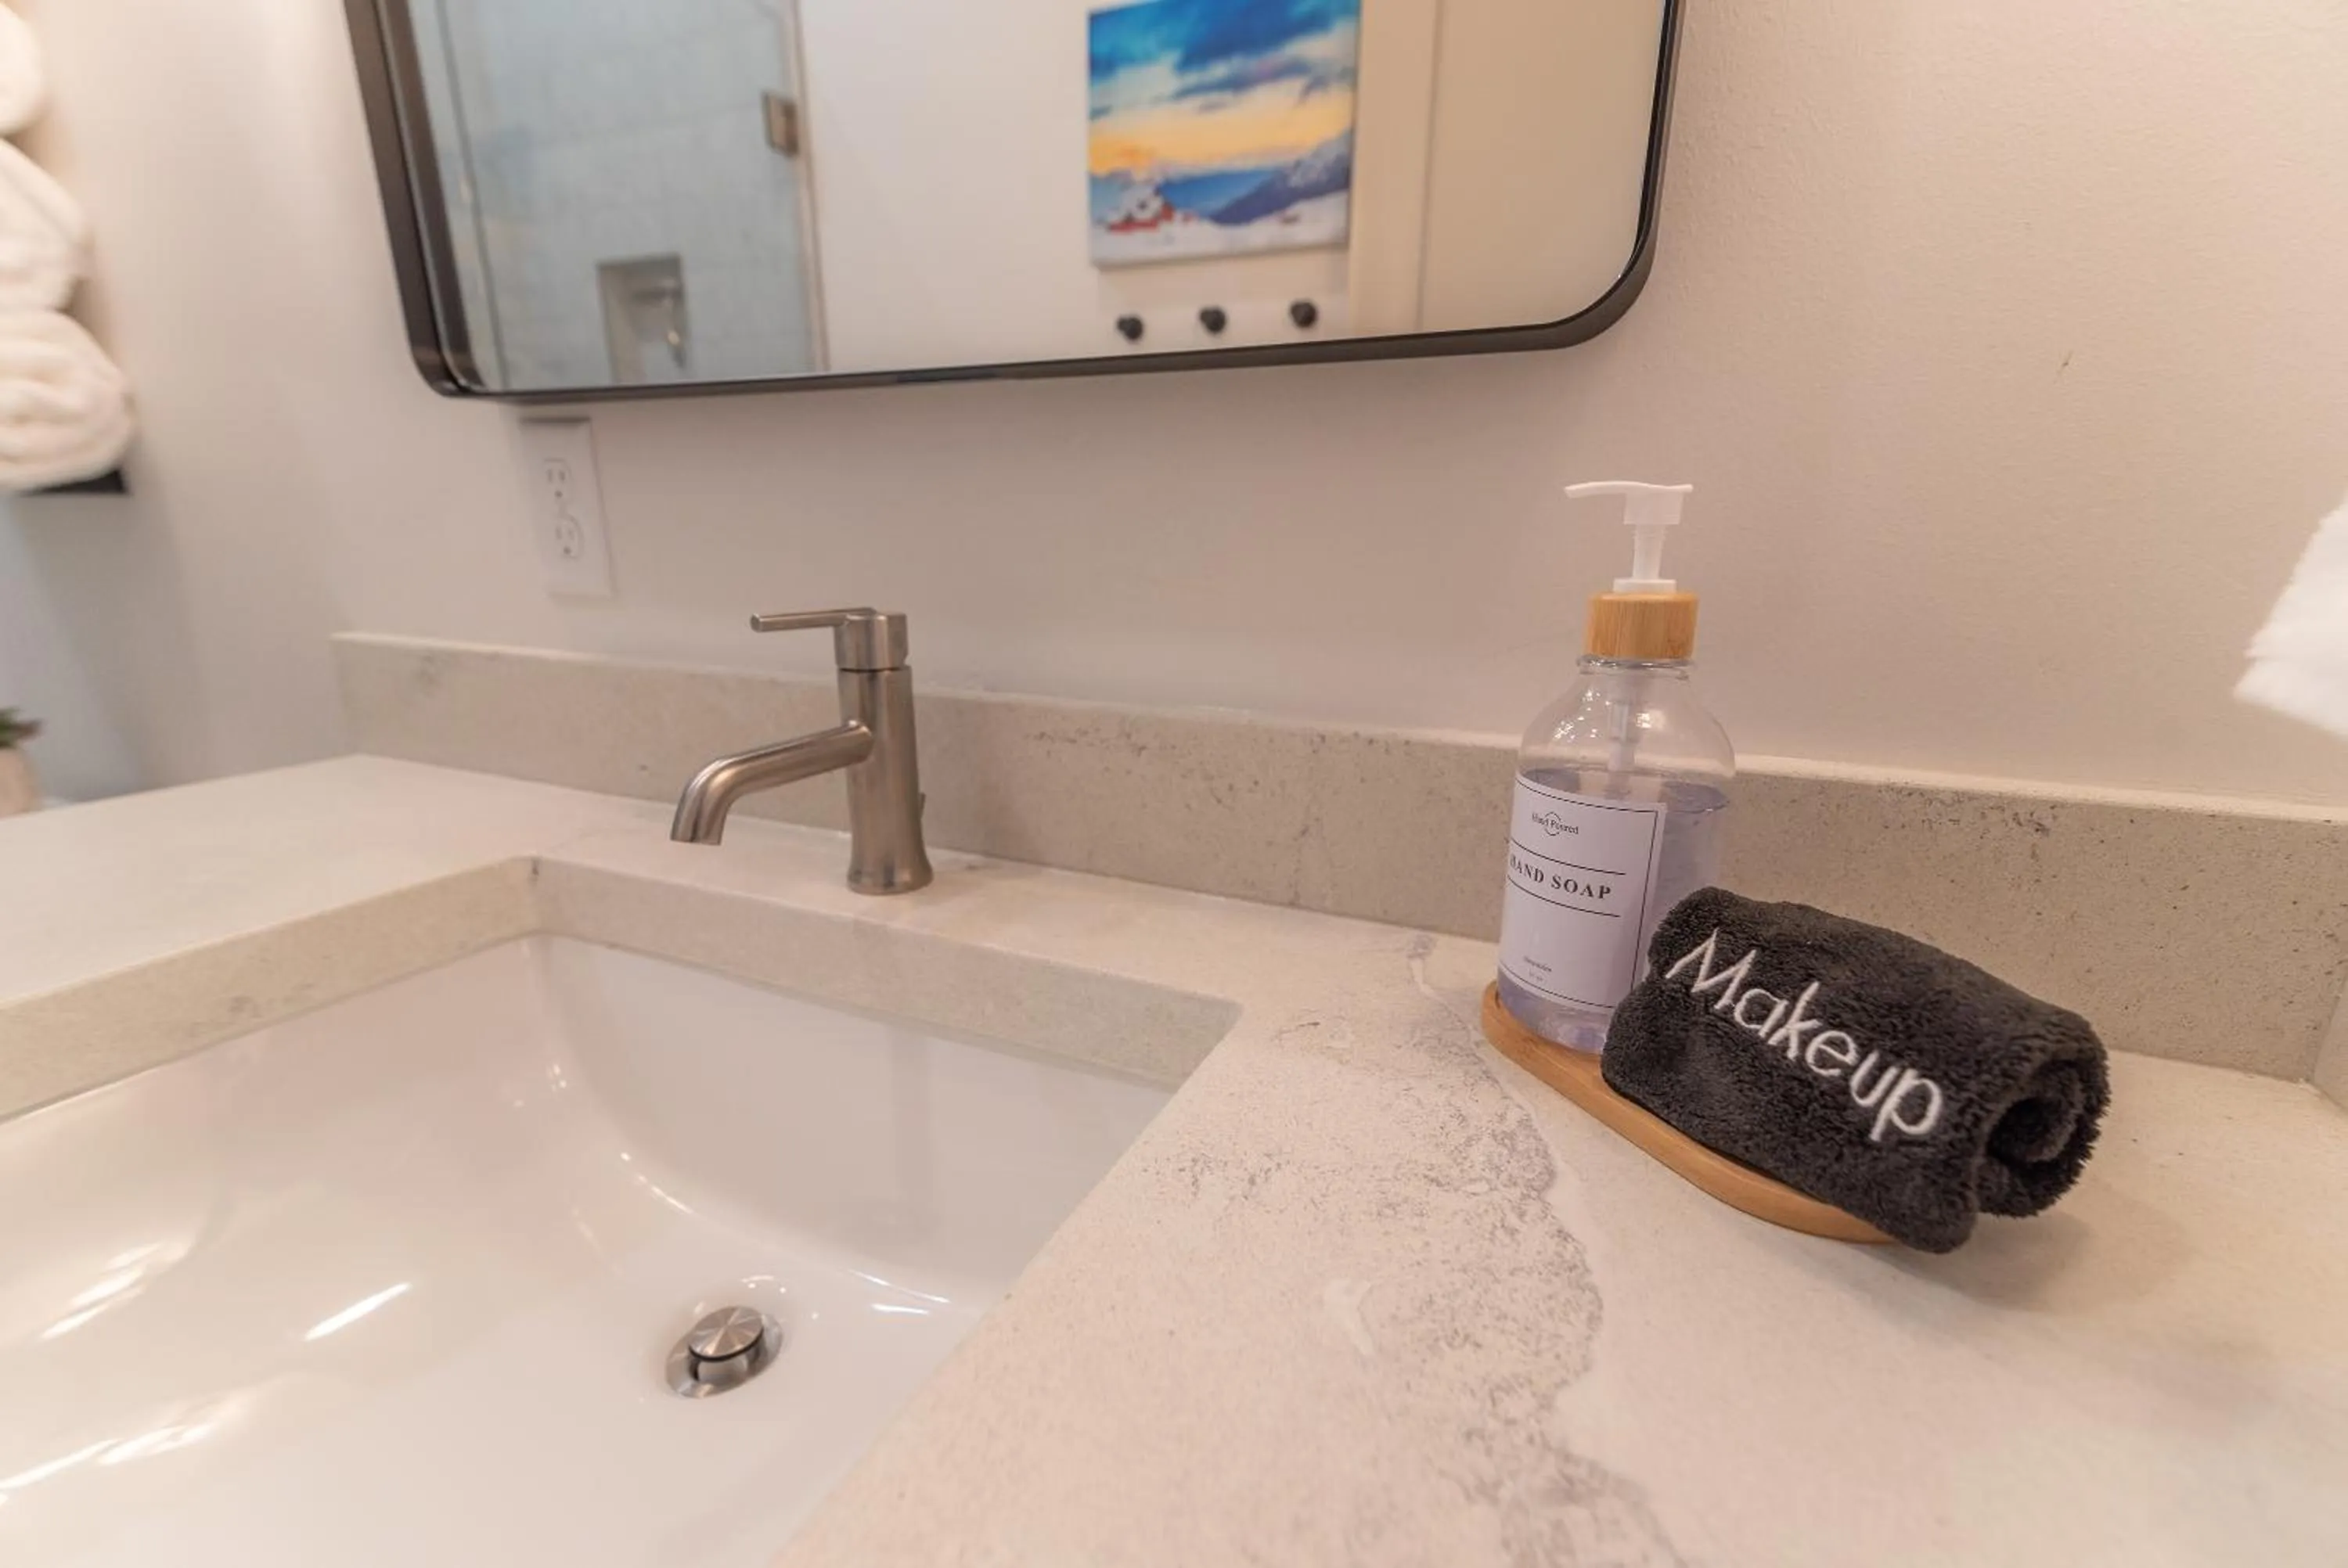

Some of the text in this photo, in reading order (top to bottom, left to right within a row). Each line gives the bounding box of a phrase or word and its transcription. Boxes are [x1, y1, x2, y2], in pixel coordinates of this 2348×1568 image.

[1509, 854, 1612, 899] HAND SOAP
[1665, 927, 1943, 1142] Makeup
